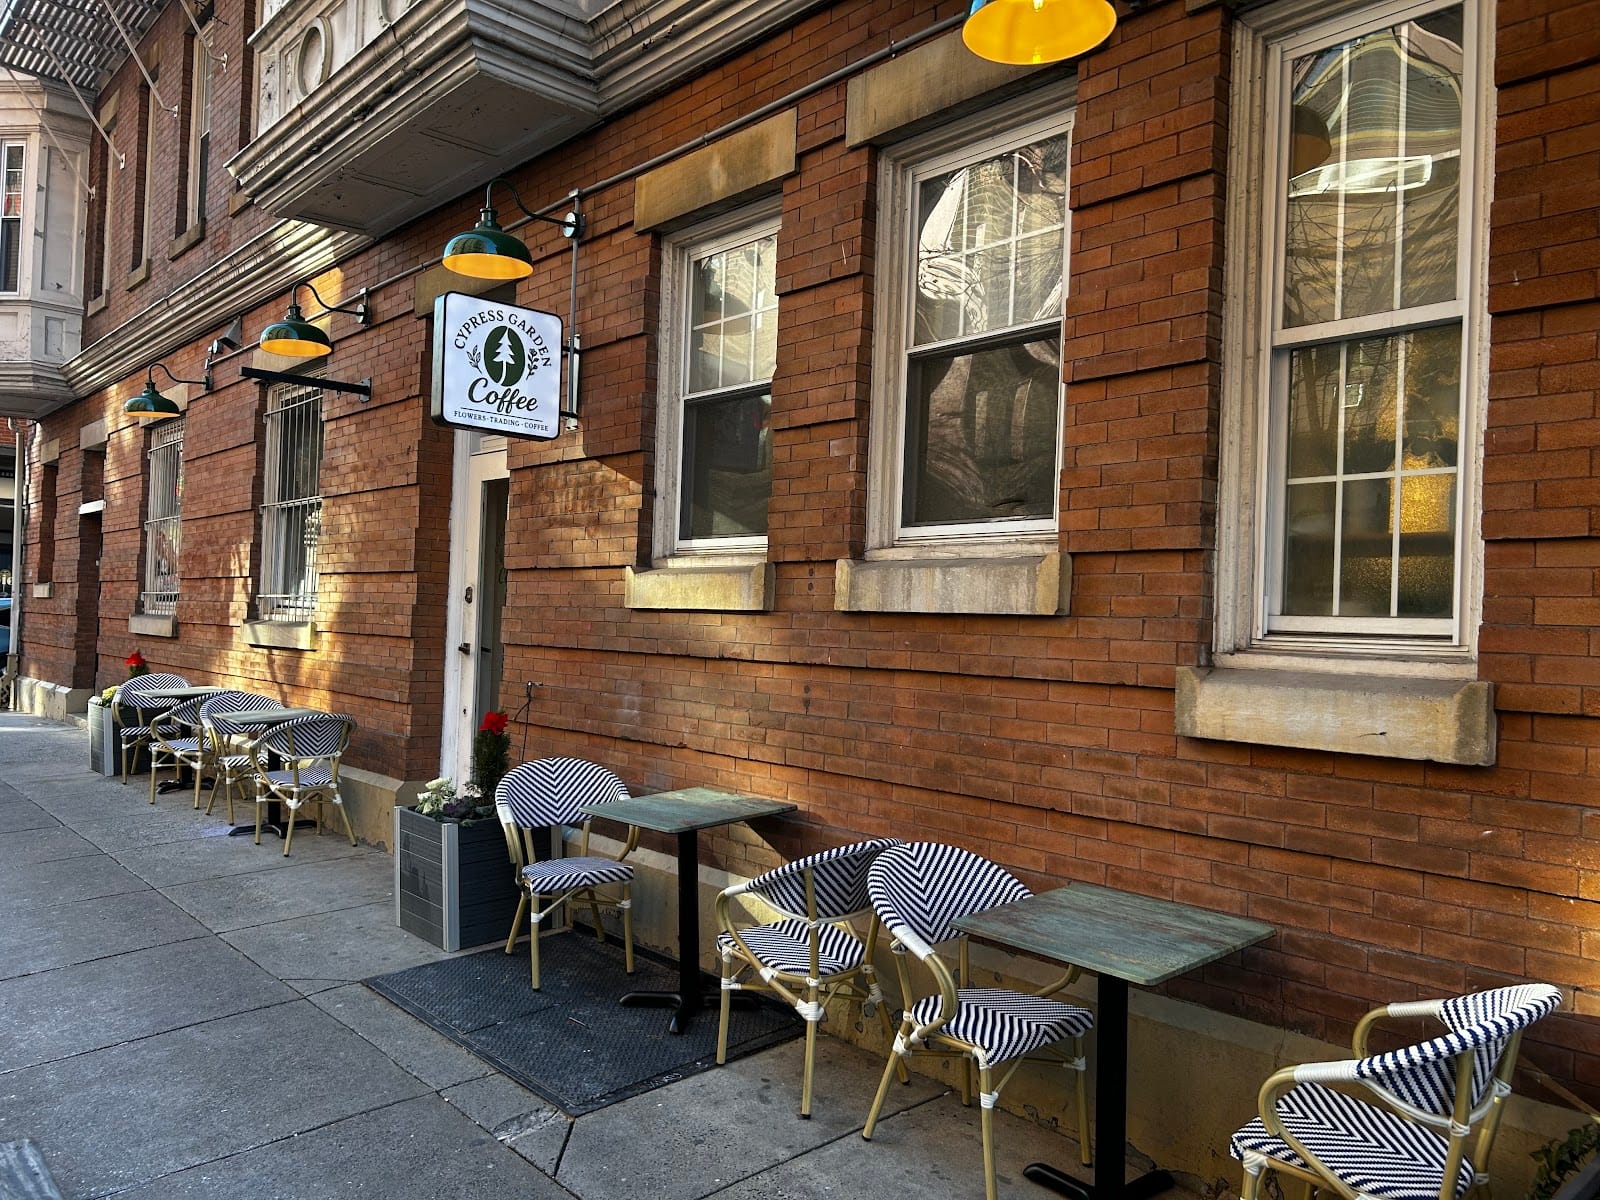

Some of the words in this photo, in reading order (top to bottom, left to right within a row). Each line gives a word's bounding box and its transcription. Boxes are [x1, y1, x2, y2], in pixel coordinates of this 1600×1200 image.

[454, 309, 504, 349] CYPRESS
[508, 313, 552, 367] GARDEN
[468, 377, 539, 414] Coffee
[454, 410, 487, 421] FLOWERS
[490, 416, 520, 427] TRADING
[524, 421, 549, 432] COFFEE
